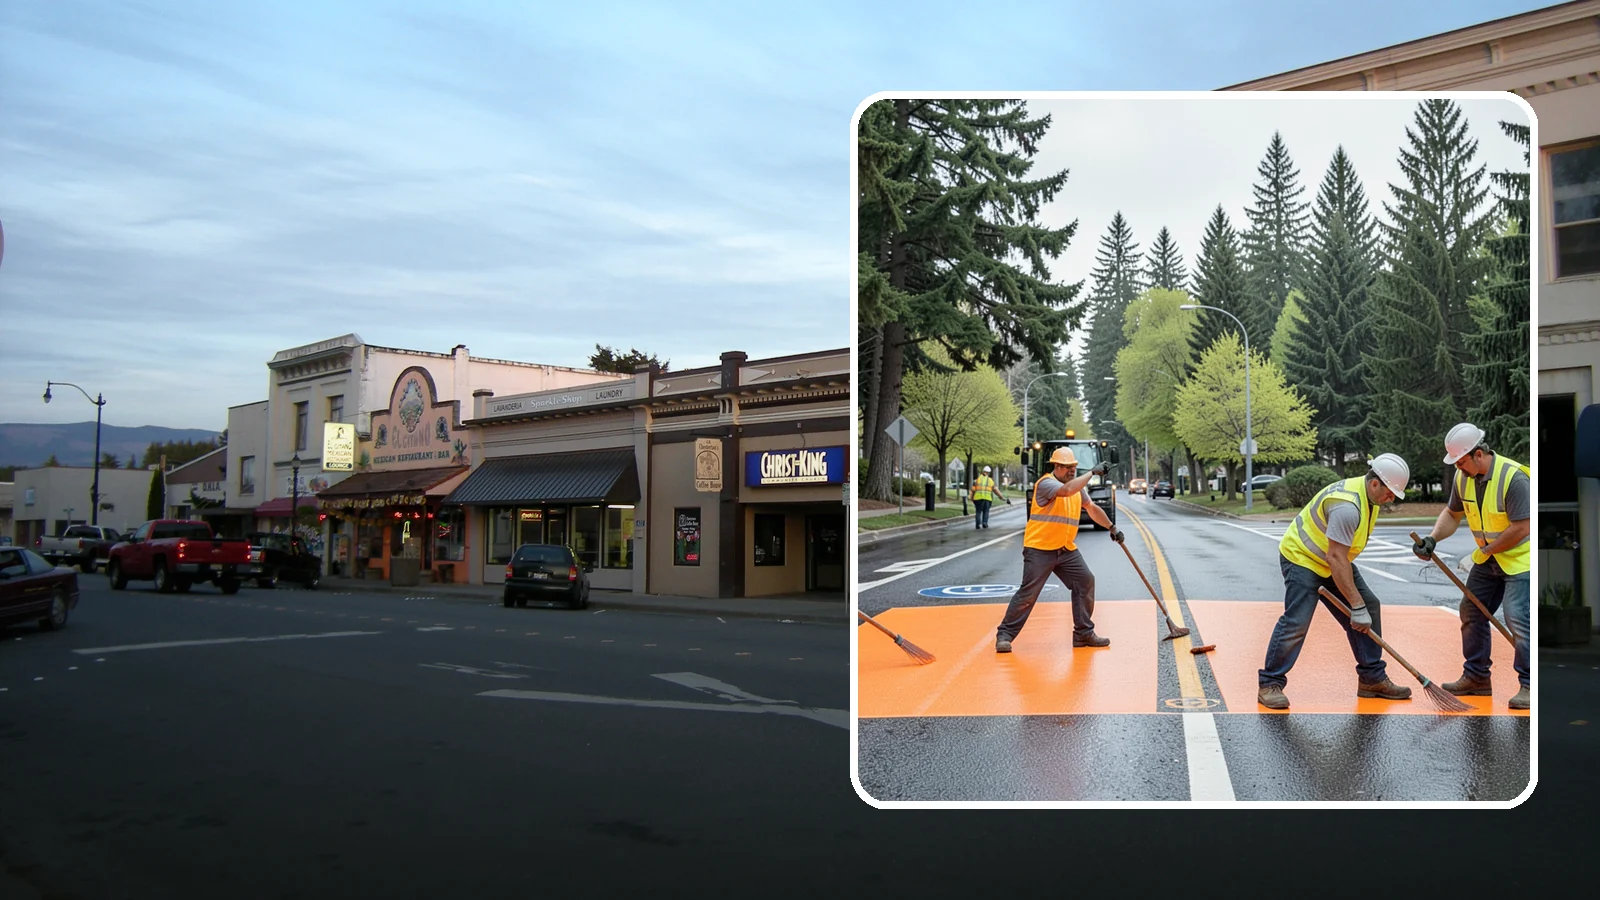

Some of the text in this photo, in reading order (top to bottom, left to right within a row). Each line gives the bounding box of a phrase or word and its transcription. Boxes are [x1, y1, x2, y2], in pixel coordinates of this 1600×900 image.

[595, 389, 624, 400] LAUNDRY
[561, 395, 583, 407] Shop
[493, 402, 523, 413] LAVANDERIA
[397, 451, 434, 462] RESTAURANT
[437, 450, 450, 459] BAR
[799, 450, 827, 476] KING
